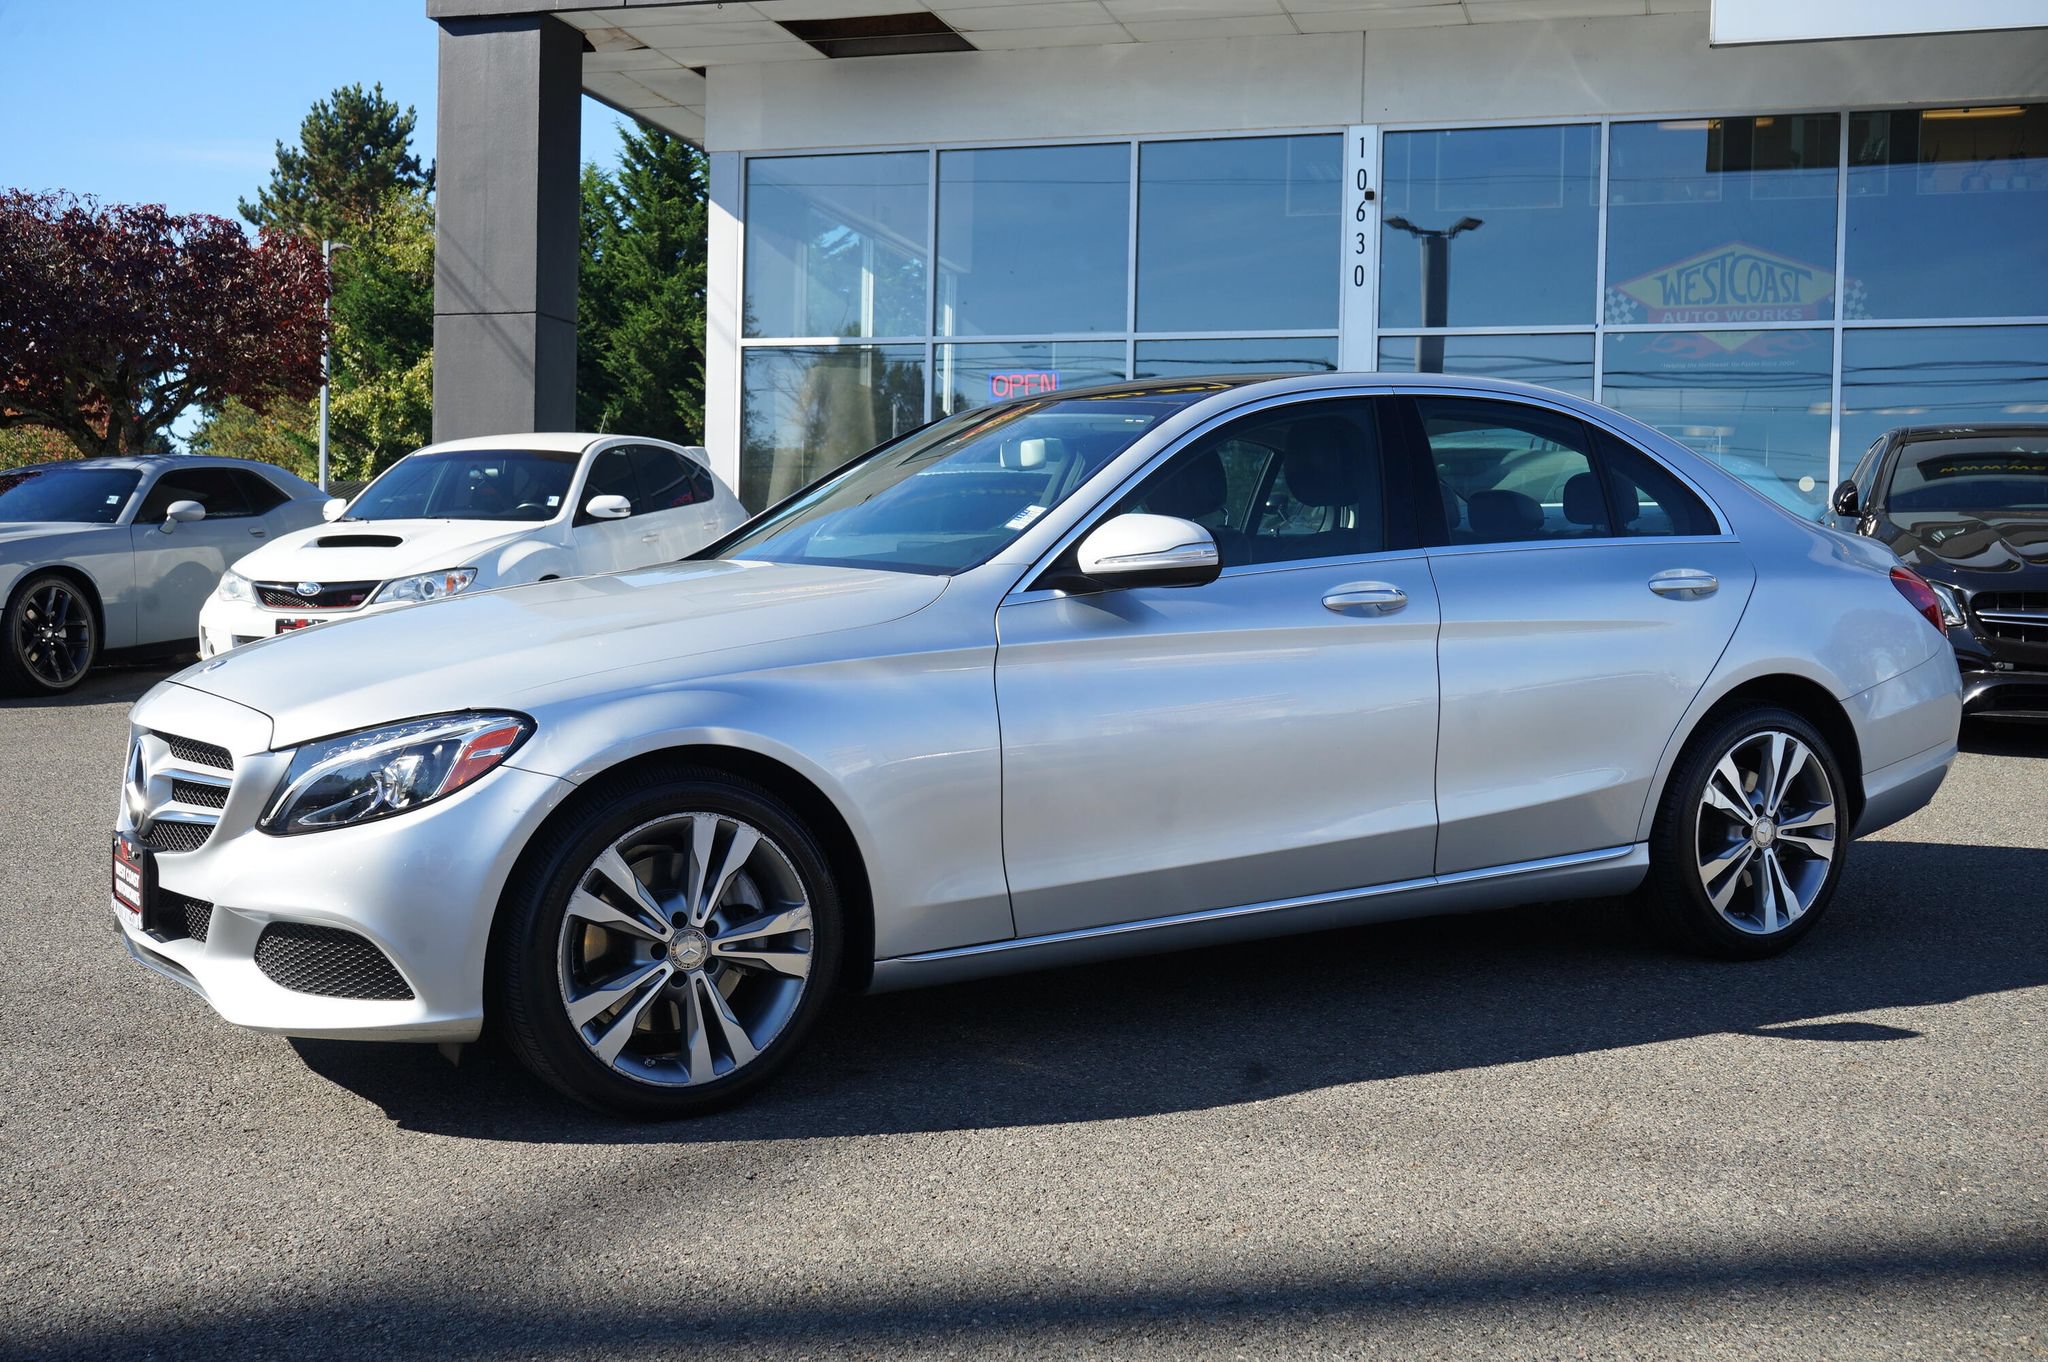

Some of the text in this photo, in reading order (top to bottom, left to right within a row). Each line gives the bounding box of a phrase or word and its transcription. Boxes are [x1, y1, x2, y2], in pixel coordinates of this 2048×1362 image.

[1354, 137, 1367, 287] 10630
[1662, 308, 1802, 323] AUTO WORKS
[992, 373, 1057, 399] OPEN
